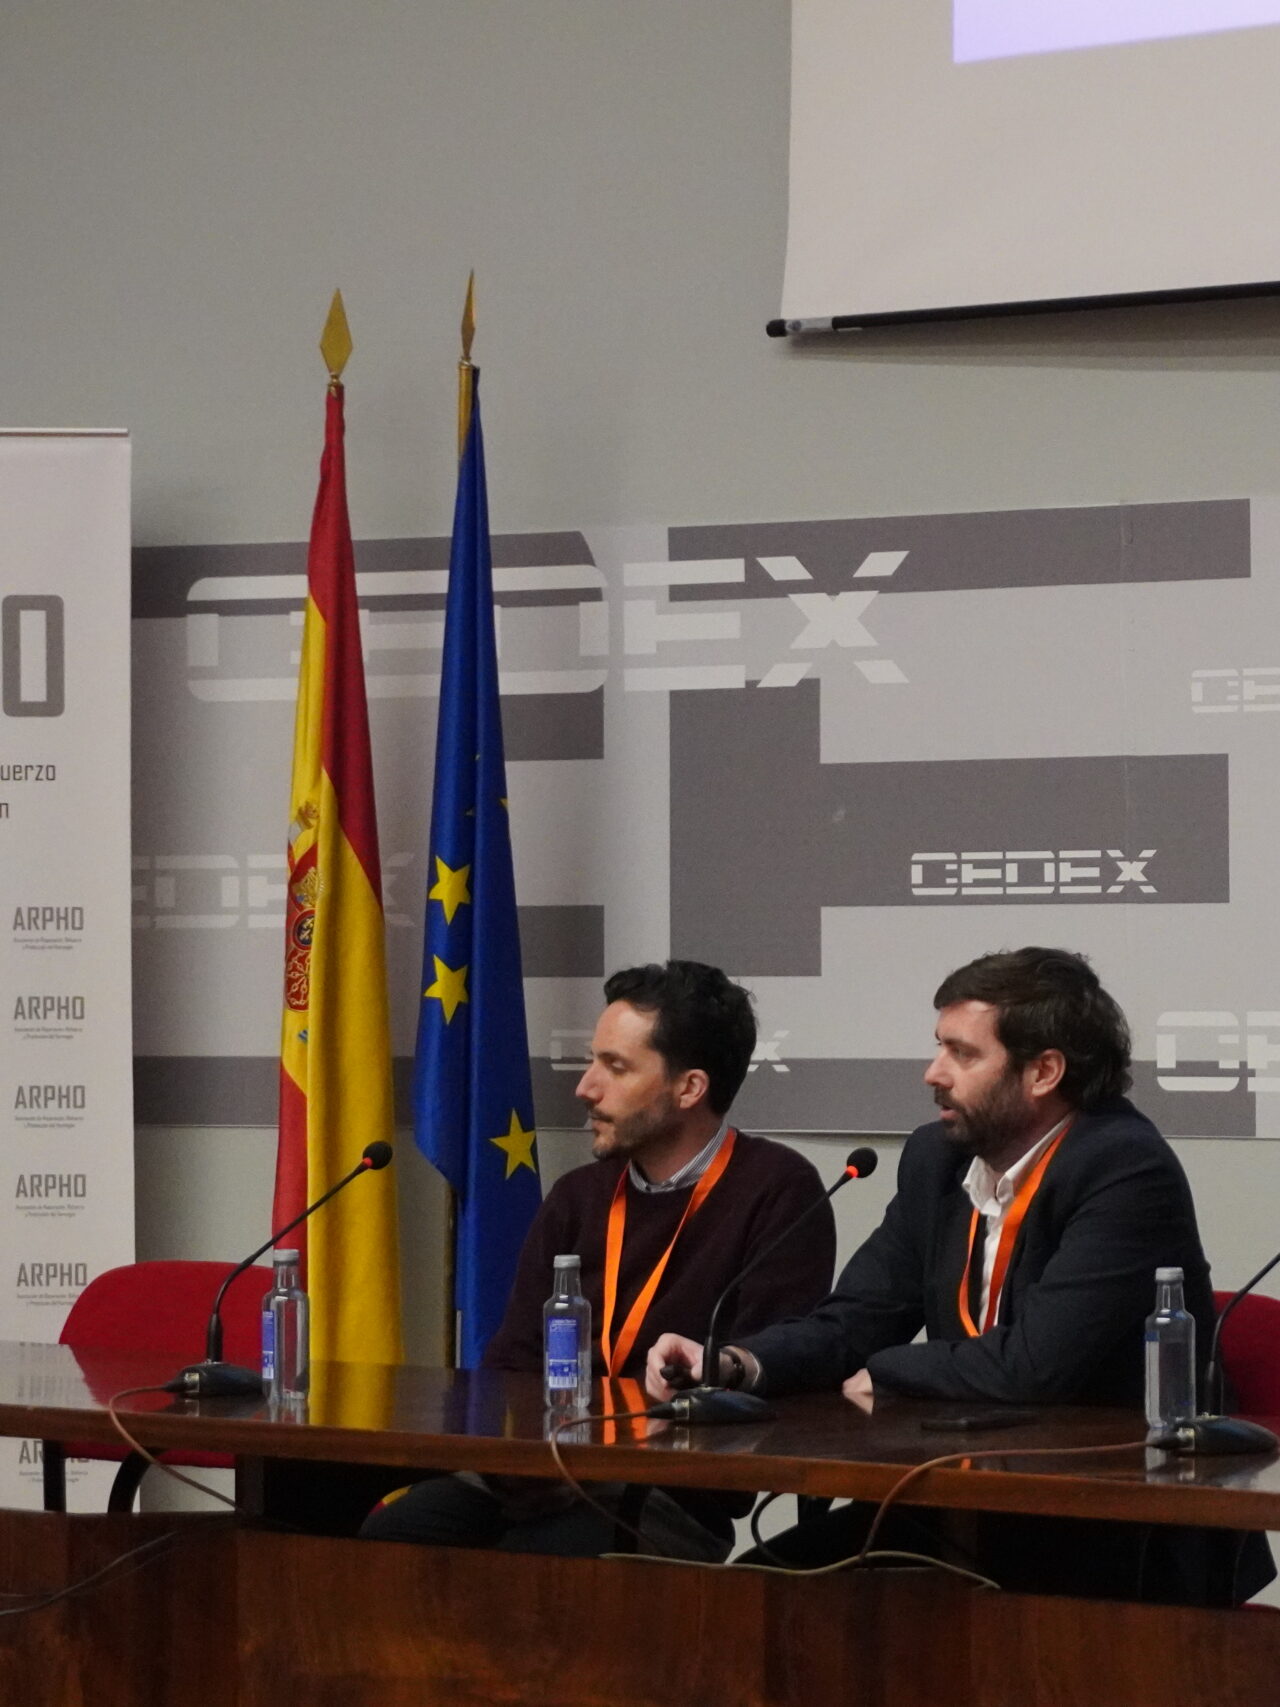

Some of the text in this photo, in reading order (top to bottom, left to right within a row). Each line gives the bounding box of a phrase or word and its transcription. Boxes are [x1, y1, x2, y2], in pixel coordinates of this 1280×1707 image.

[0, 764, 56, 781] uerzo
[911, 849, 1158, 897] CEDEX
[12, 906, 84, 931] ARPHO
[14, 995, 85, 1020] ARPHO
[14, 1085, 86, 1109] ARPHO
[15, 1173, 87, 1198] ARPHO
[16, 1262, 87, 1287] ARPHO
